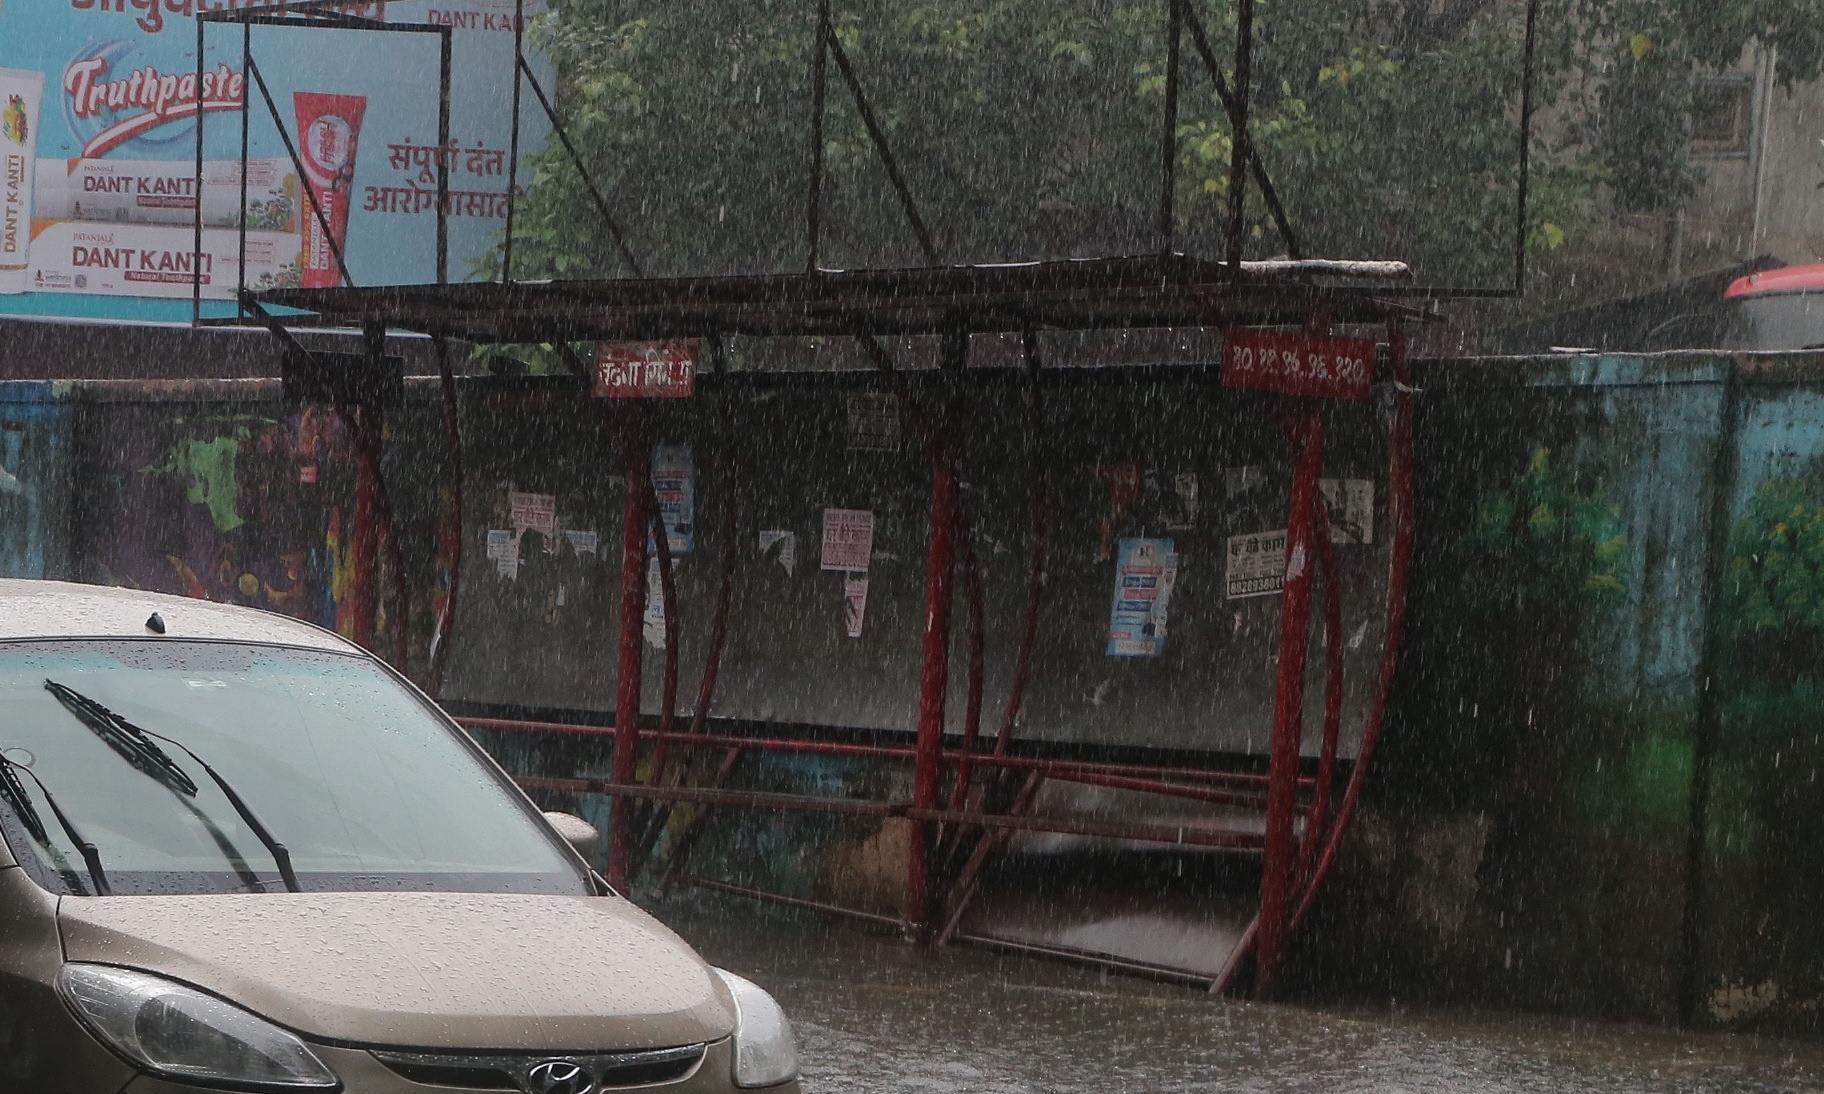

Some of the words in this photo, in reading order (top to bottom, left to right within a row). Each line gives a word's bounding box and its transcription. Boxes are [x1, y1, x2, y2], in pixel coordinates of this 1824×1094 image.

[65, 57, 244, 117] Truthpaste
[465, 141, 505, 177] दंत
[6, 155, 20, 204] KANTI
[84, 176, 133, 194] DANT
[137, 177, 195, 195] KANT
[4, 208, 18, 253] DANT
[72, 246, 135, 268] DANT
[140, 249, 212, 273] KANTI
